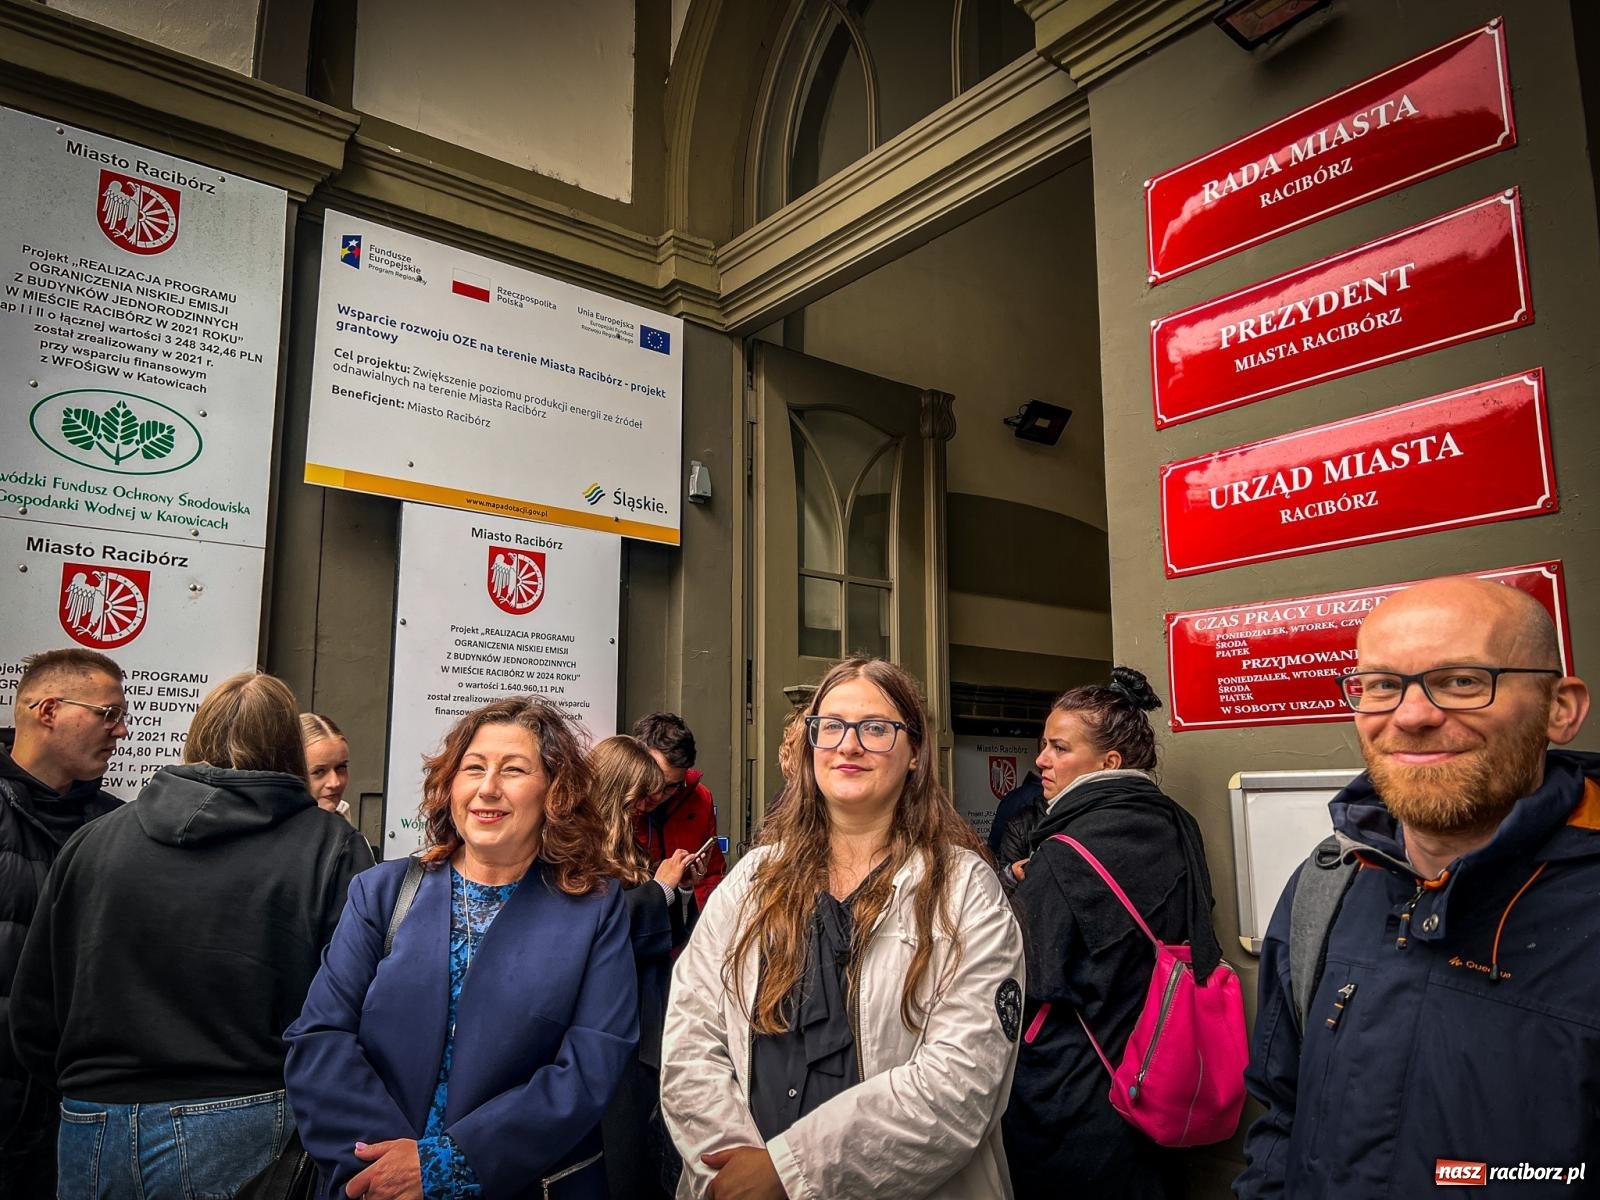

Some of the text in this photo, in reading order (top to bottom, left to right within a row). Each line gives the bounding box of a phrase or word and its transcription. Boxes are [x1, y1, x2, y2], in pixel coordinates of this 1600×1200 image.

[1201, 94, 1419, 205] RADA MIASTA
[66, 140, 216, 194] Miasto Racibórz
[1260, 157, 1353, 208] RACIBÓRZ
[369, 245, 412, 262] Fundusze
[369, 254, 421, 274] Europejskie
[22, 245, 237, 303] Projekt „REALIZACJA PROGRAMU
[368, 264, 394, 276] Program
[30, 261, 228, 315] OGRANICZENIA NISKIEJ EMISJI
[497, 287, 557, 310] Rzeczpospolita
[5, 286, 19, 296] W
[23, 289, 79, 310] MIEŚCIE
[84, 303, 152, 326] RACIBÓRZ
[156, 318, 168, 329] W
[171, 322, 199, 335] 2021
[15, 272, 238, 331] Z BUDYNKÓW JEDNORODZINNYCH
[497, 295, 524, 309] Polska
[1219, 263, 1415, 349] PREZYDENT
[578, 307, 634, 329] Unia Europejska
[0, 301, 16, 312] ap
[28, 305, 32, 315] i
[48, 312, 56, 320] o
[60, 312, 105, 331] łącznej
[109, 323, 161, 343] wartości
[175, 337, 196, 349] 248
[200, 343, 236, 358] 342,46
[240, 350, 262, 363] PLN
[336, 320, 398, 344] grantowy
[1235, 308, 1402, 372] MIASTA RACIBÓRZ
[34, 323, 214, 367] został zrealizowany w 2021 r.
[337, 304, 666, 399] Wsparcie rozwoju OZE na terenie Miasta Racibórz projekt
[40, 340, 207, 380] przy wsparciu finansowym
[41, 355, 48, 363] z
[51, 353, 120, 377] WFOŚiGW
[137, 372, 207, 393] Katowicach
[333, 362, 547, 419] odnawialnych na terenie Miasta Racibórz
[334, 348, 643, 429] Cel projektu: Zwiększenie poziomu produkcji energii ze źródeł
[332, 384, 491, 428] Beneficjent: Miasto Racibórz
[0, 471, 47, 487] wódzki
[1208, 431, 1463, 510] URZĄD MIASTA
[466, 498, 548, 518] www.mapadotacji.gov.pl
[613, 487, 668, 514] Śląskie.
[1280, 490, 1379, 524] RACIBÓRZ
[471, 527, 563, 550] Miasto Racibórz
[26, 536, 189, 567] Miasto Racibórz
[1195, 606, 1310, 631] CZAS PRACY
[450, 625, 575, 642] Projekt „REALIZACJA PROGRAMU
[1216, 627, 1288, 640] PONIEDZIAŁEK,
[1291, 621, 1337, 633] WTOREK,
[455, 638, 569, 655] OGRANICZENIA NISKIEJ EMISJI
[1216, 640, 1247, 649] ŚRODA
[1216, 648, 1249, 658] PIĄTEK
[447, 652, 576, 668] Z BUDYNKÓW JEDNORODZINNYCH
[1242, 649, 1360, 669] PRZYJMOWANI
[132, 671, 208, 683] PROGRAMU
[441, 665, 450, 673] W
[452, 664, 483, 676] MIEŚCIE
[486, 666, 524, 678] RACIBÓRZ
[537, 671, 554, 680] 2024
[1218, 673, 1290, 685] PONIEDZIAŁEK,
[1292, 668, 1341, 678] WTOREK,
[124, 685, 199, 697] KIEJ EMISJI
[465, 680, 499, 691] wartości
[500, 684, 548, 694] 1.640.960,11
[1219, 684, 1250, 693] ŚRODA
[1220, 693, 1254, 702] PIĄTEK
[134, 701, 146, 710] W
[150, 702, 200, 712] BUDYN
[427, 692, 451, 702] został
[559, 699, 590, 708] wsparciu
[1220, 706, 1232, 714] W
[1234, 703, 1286, 714] SOBOTY
[1289, 700, 1335, 710] URZĄD
[435, 707, 474, 716] finansow
[137, 732, 165, 741] 2021
[156, 748, 181, 756] PLN
